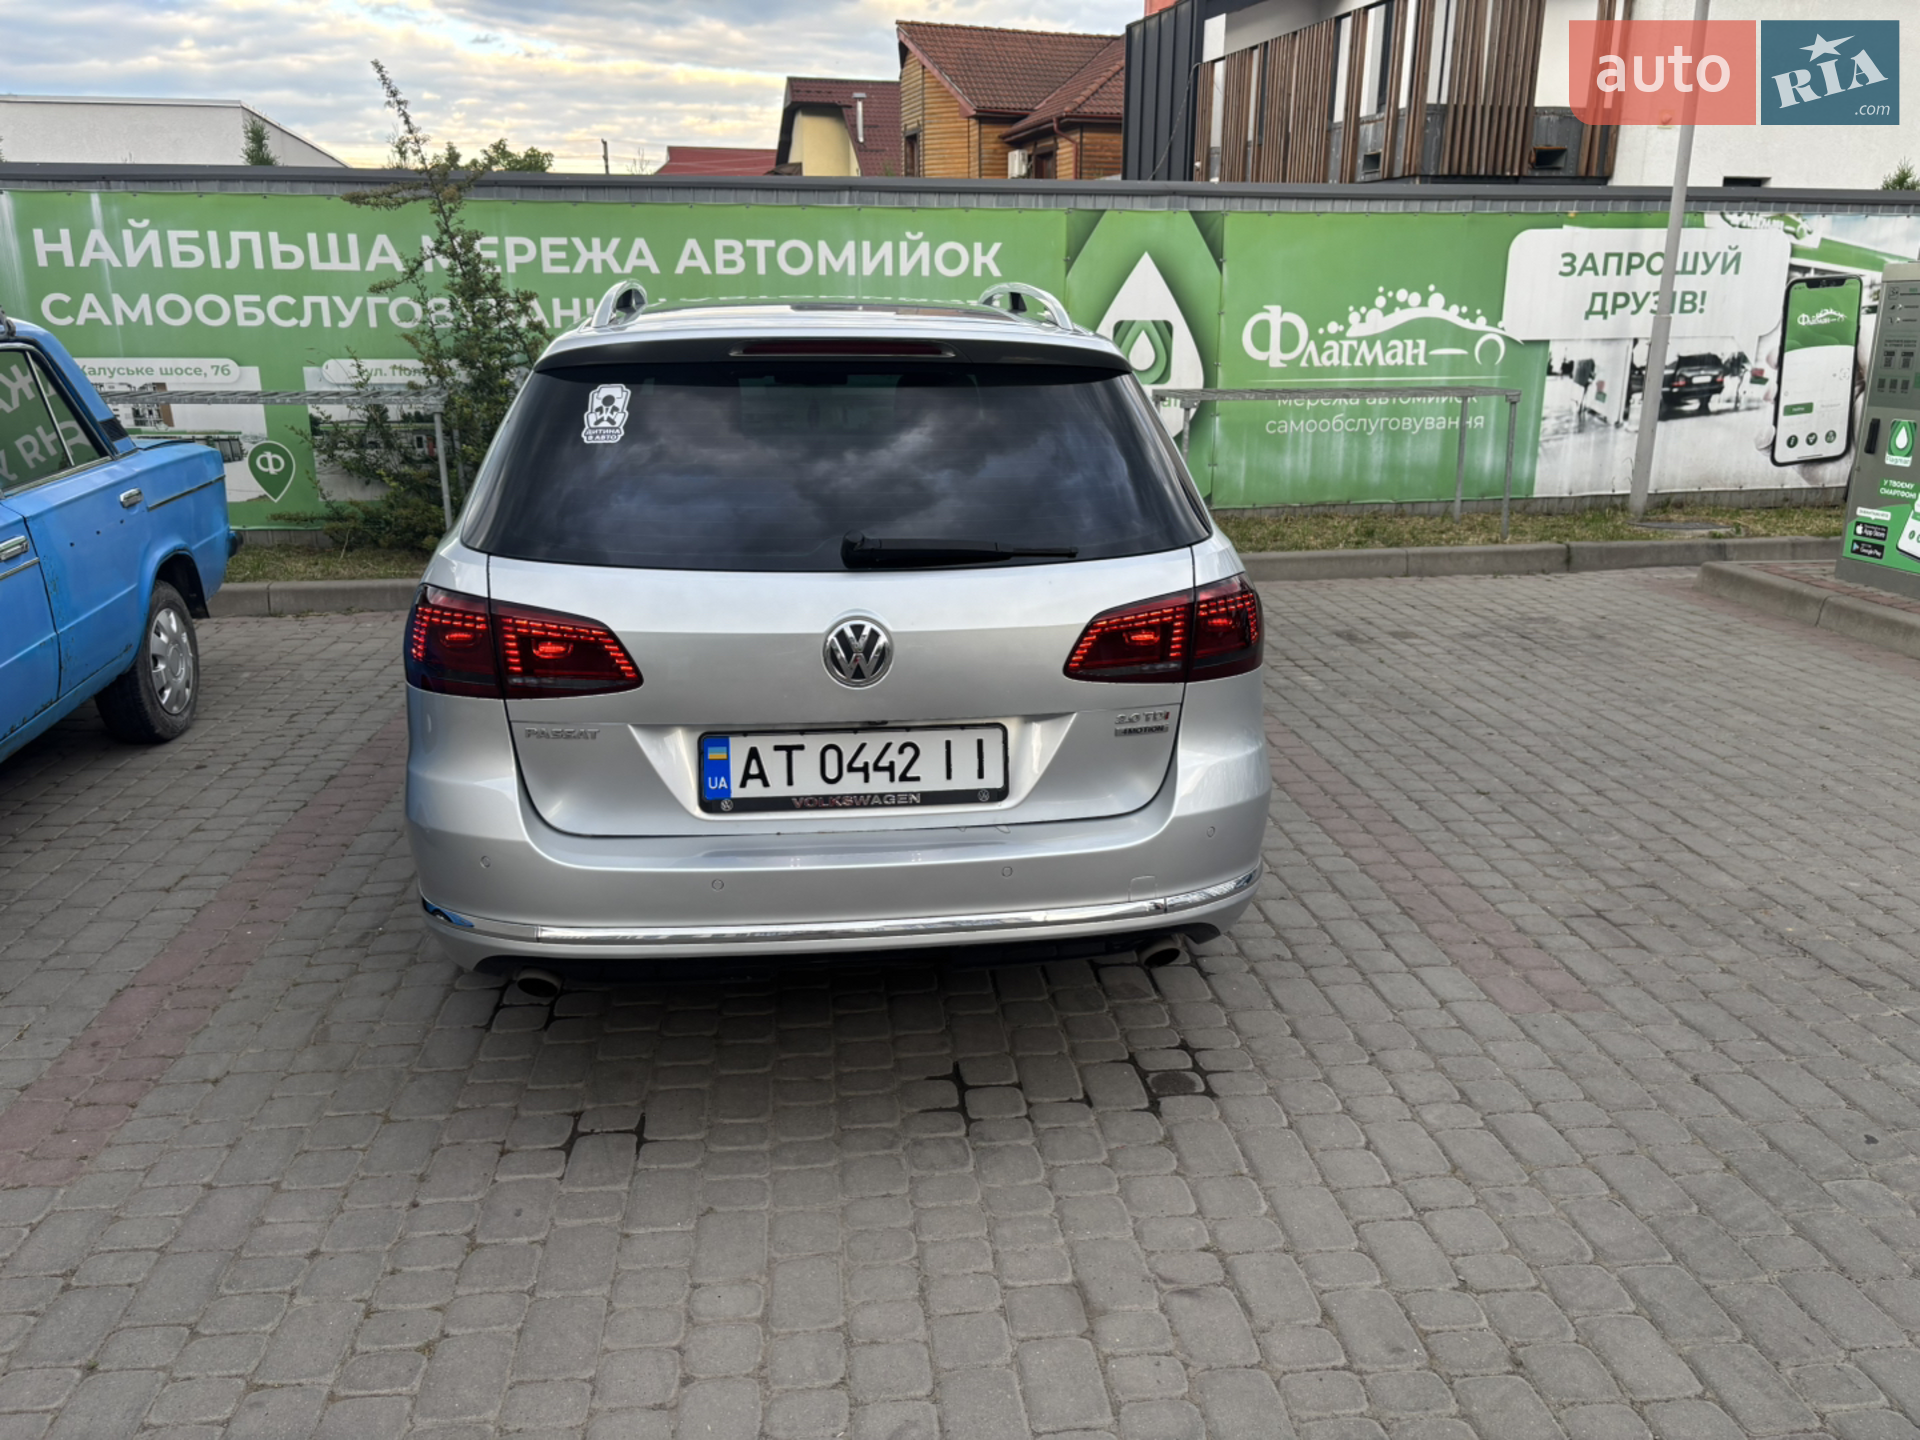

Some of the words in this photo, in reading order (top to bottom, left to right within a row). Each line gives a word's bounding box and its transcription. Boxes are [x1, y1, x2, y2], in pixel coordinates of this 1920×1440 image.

[33, 219, 405, 272] НАЙБІЛЬША
[674, 231, 1003, 277] АВТОМИЙОК
[1558, 245, 1742, 277] ЗАПРОШУЙ
[1584, 290, 1708, 321] ДРУЗІВ!
[1242, 304, 1429, 368] Флагман
[159, 366, 208, 379] шосе,
[359, 367, 387, 380] ул.
[524, 727, 600, 741] PASSAT
[739, 744, 806, 789] AT
[819, 741, 921, 785] 0442
[708, 776, 729, 790] UA
[791, 793, 921, 809] VOLKSWAGEN
